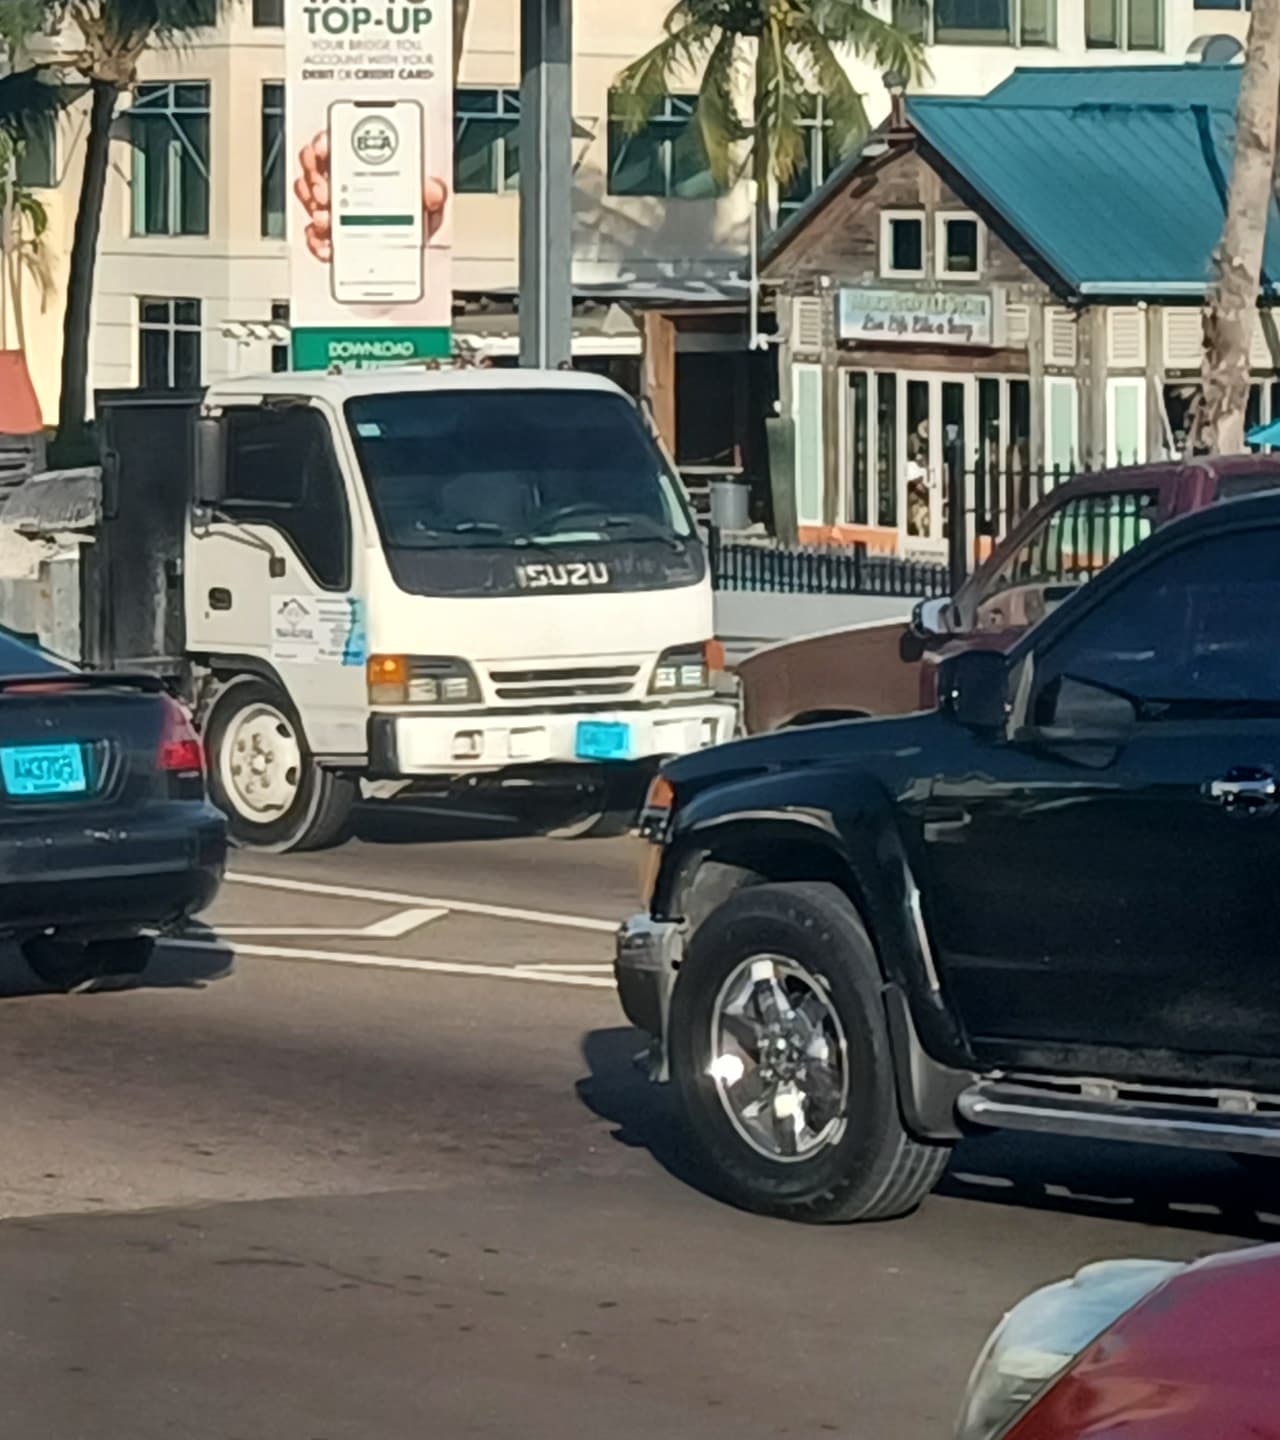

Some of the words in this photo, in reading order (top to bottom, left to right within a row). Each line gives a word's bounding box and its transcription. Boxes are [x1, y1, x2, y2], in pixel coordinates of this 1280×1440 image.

[303, 7, 432, 34] TOP-UP
[328, 341, 415, 357] DOWNLOAD
[515, 561, 609, 588] ISUZU
